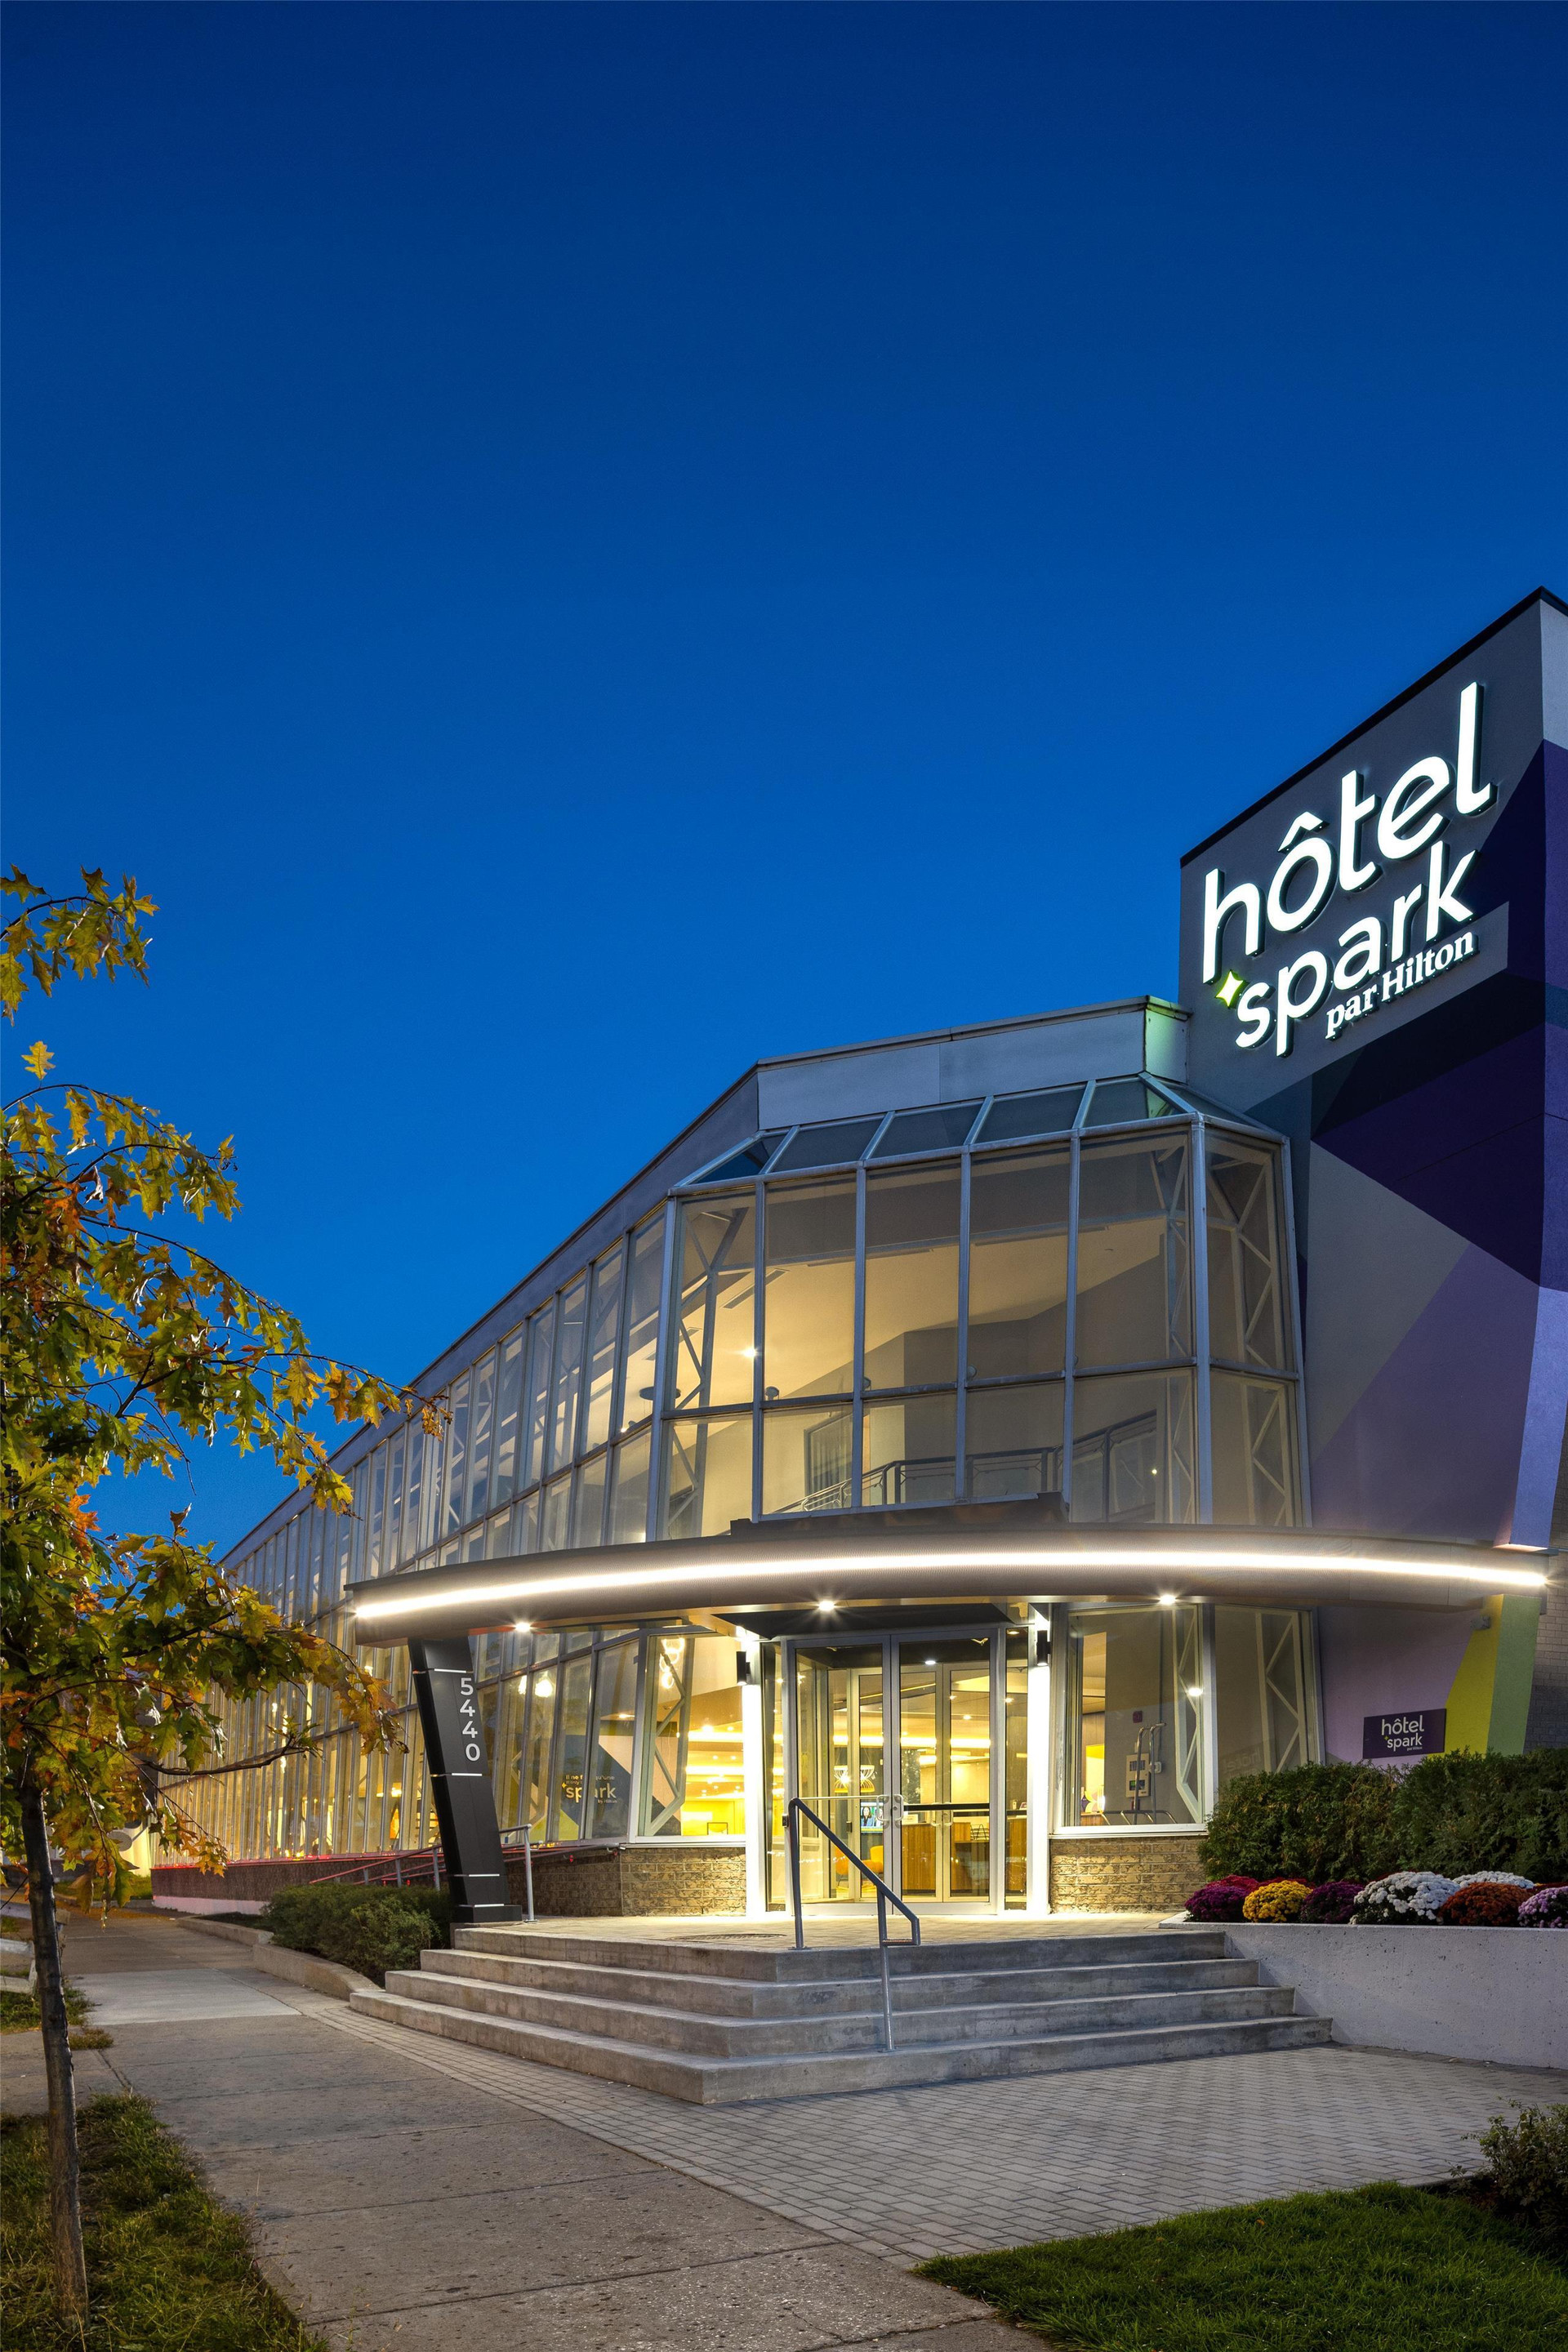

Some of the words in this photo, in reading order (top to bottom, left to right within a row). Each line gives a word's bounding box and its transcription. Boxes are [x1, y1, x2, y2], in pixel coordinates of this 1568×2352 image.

[1202, 681, 1492, 984] hôtel
[1235, 840, 1478, 1057] spark
[1325, 983, 1378, 1040] par
[1381, 931, 1474, 1002] Hilton
[459, 1677, 481, 1762] 5440
[1381, 1714, 1425, 1736] hôtel
[1387, 1732, 1423, 1752] spark
